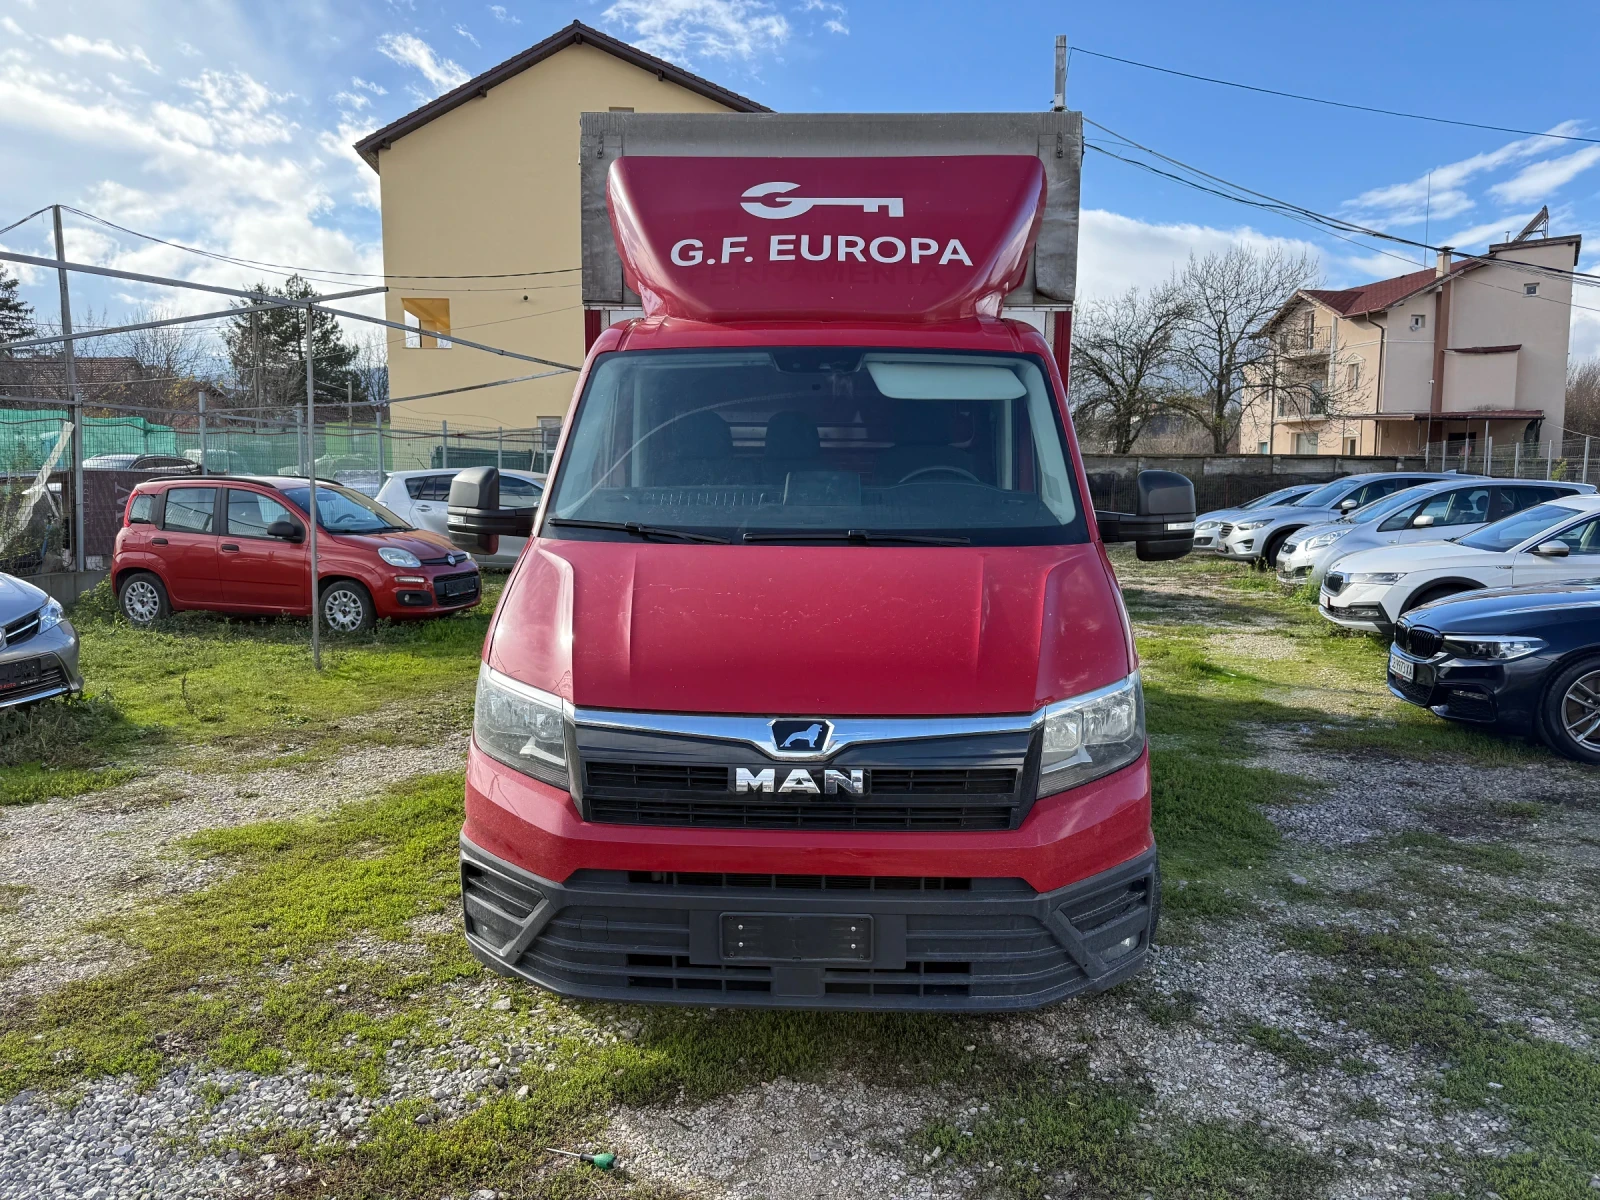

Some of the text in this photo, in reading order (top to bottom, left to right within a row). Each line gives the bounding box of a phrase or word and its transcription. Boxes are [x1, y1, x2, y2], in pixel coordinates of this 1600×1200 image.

[670, 234, 974, 267] G.F. EUROPA
[735, 767, 864, 794] MAN
